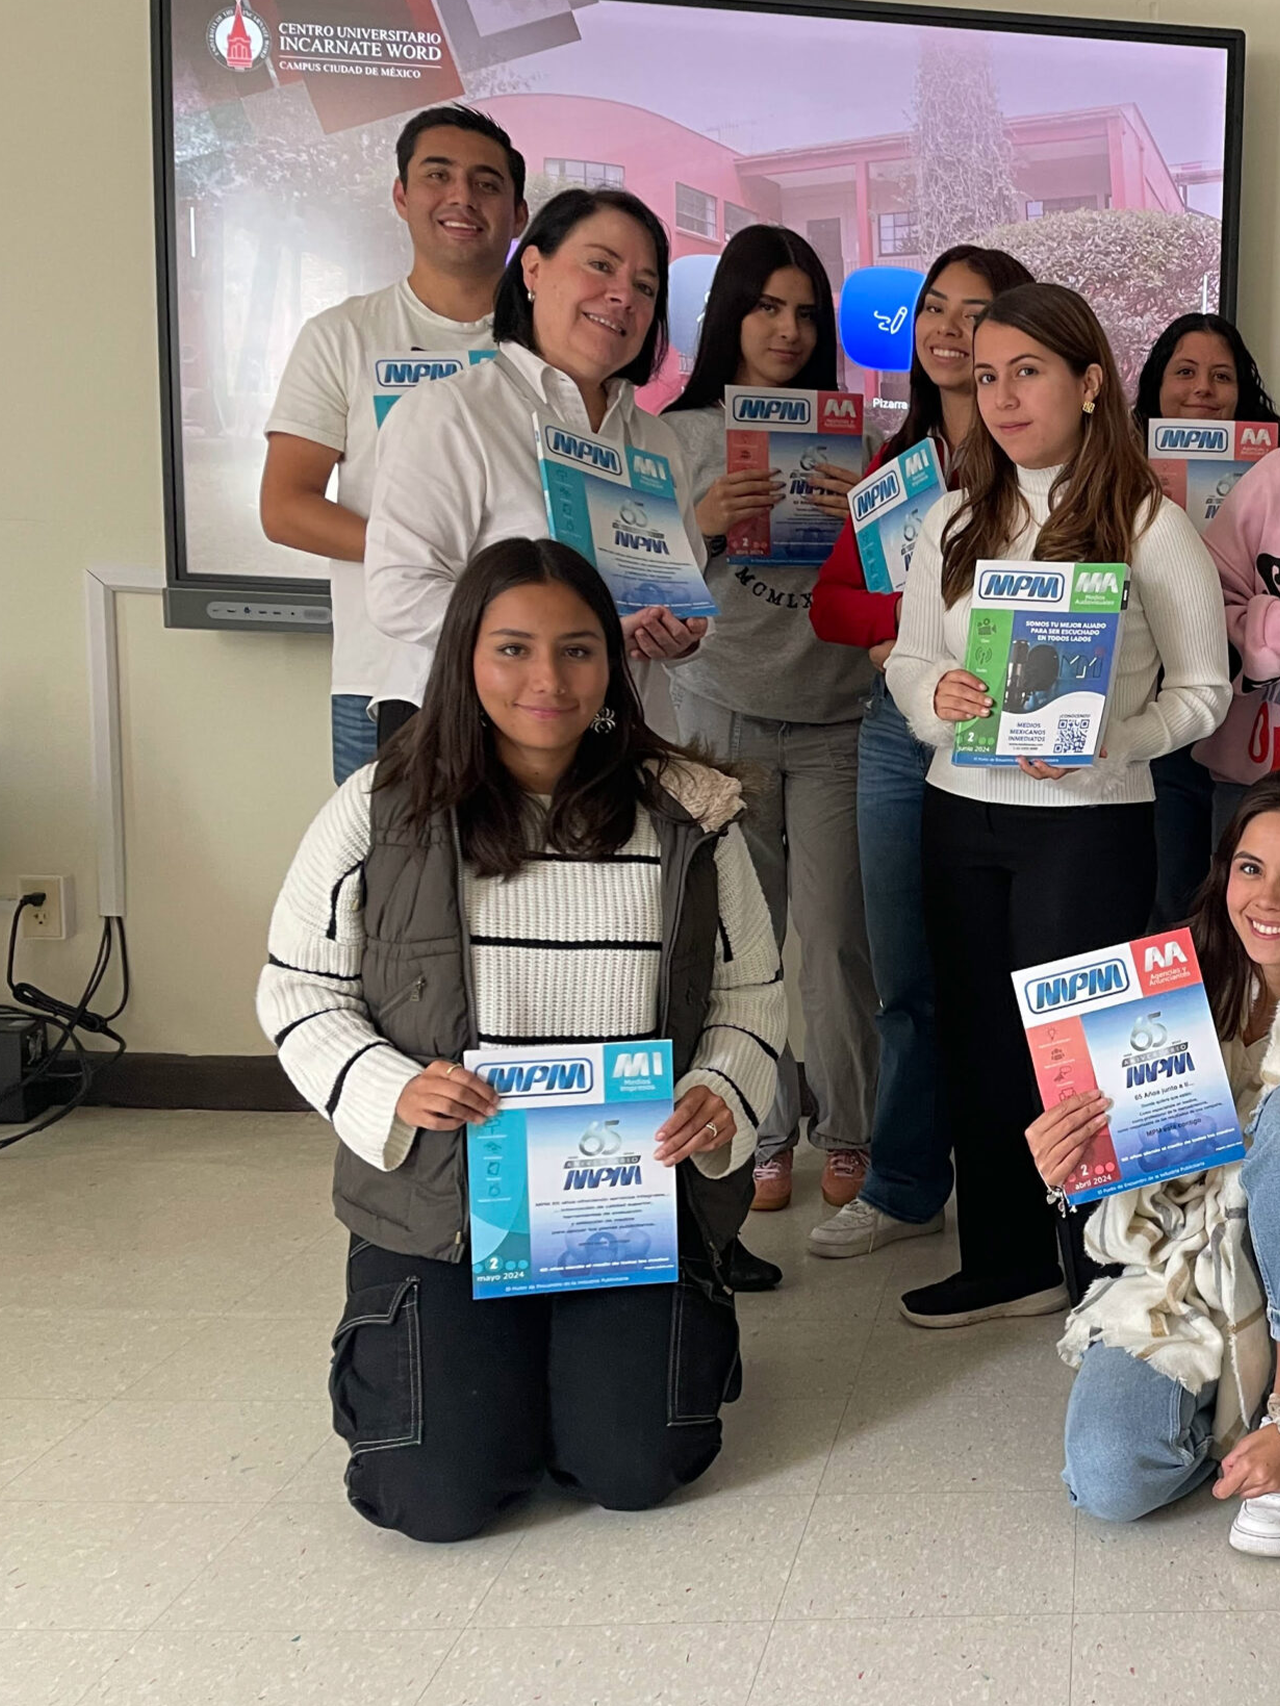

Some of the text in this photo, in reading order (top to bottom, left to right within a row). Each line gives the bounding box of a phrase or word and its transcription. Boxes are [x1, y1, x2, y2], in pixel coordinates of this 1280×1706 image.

[279, 23, 441, 44] CENTRO UNIVERSITARIO
[279, 36, 442, 61] INCARNATE WORD
[279, 61, 421, 78] CAMPUS CIUDAD DE MÉXICO
[739, 399, 856, 420] MPM AA
[873, 398, 908, 410] Pizarra
[1160, 428, 1271, 449] MPM AA
[553, 432, 618, 471] MPM
[634, 455, 667, 481] MI
[905, 449, 930, 478] MI
[857, 475, 897, 518] MPM
[615, 531, 670, 555] MPM
[984, 572, 1119, 598] MPM MA
[1026, 620, 1050, 628] SOMOS
[967, 732, 974, 741] 2
[1144, 941, 1188, 972] AA
[1149, 971, 1190, 987] Anunciantes
[1150, 968, 1181, 980] Agencias
[1036, 964, 1124, 1010] MPM
[1130, 1011, 1167, 1052] 65
[486, 1052, 663, 1094] MPM MI
[1126, 1051, 1195, 1089] MPM
[1135, 1093, 1143, 1101] 65
[1144, 1089, 1160, 1099] Años
[1161, 1085, 1177, 1095] junto
[578, 1120, 622, 1156] 65
[563, 1165, 642, 1190] MPM
[1081, 1165, 1089, 1176] 2
[1075, 1174, 1112, 1190] abril 2024
[489, 1258, 498, 1269] 2
[477, 1271, 525, 1282] mayo 2024
